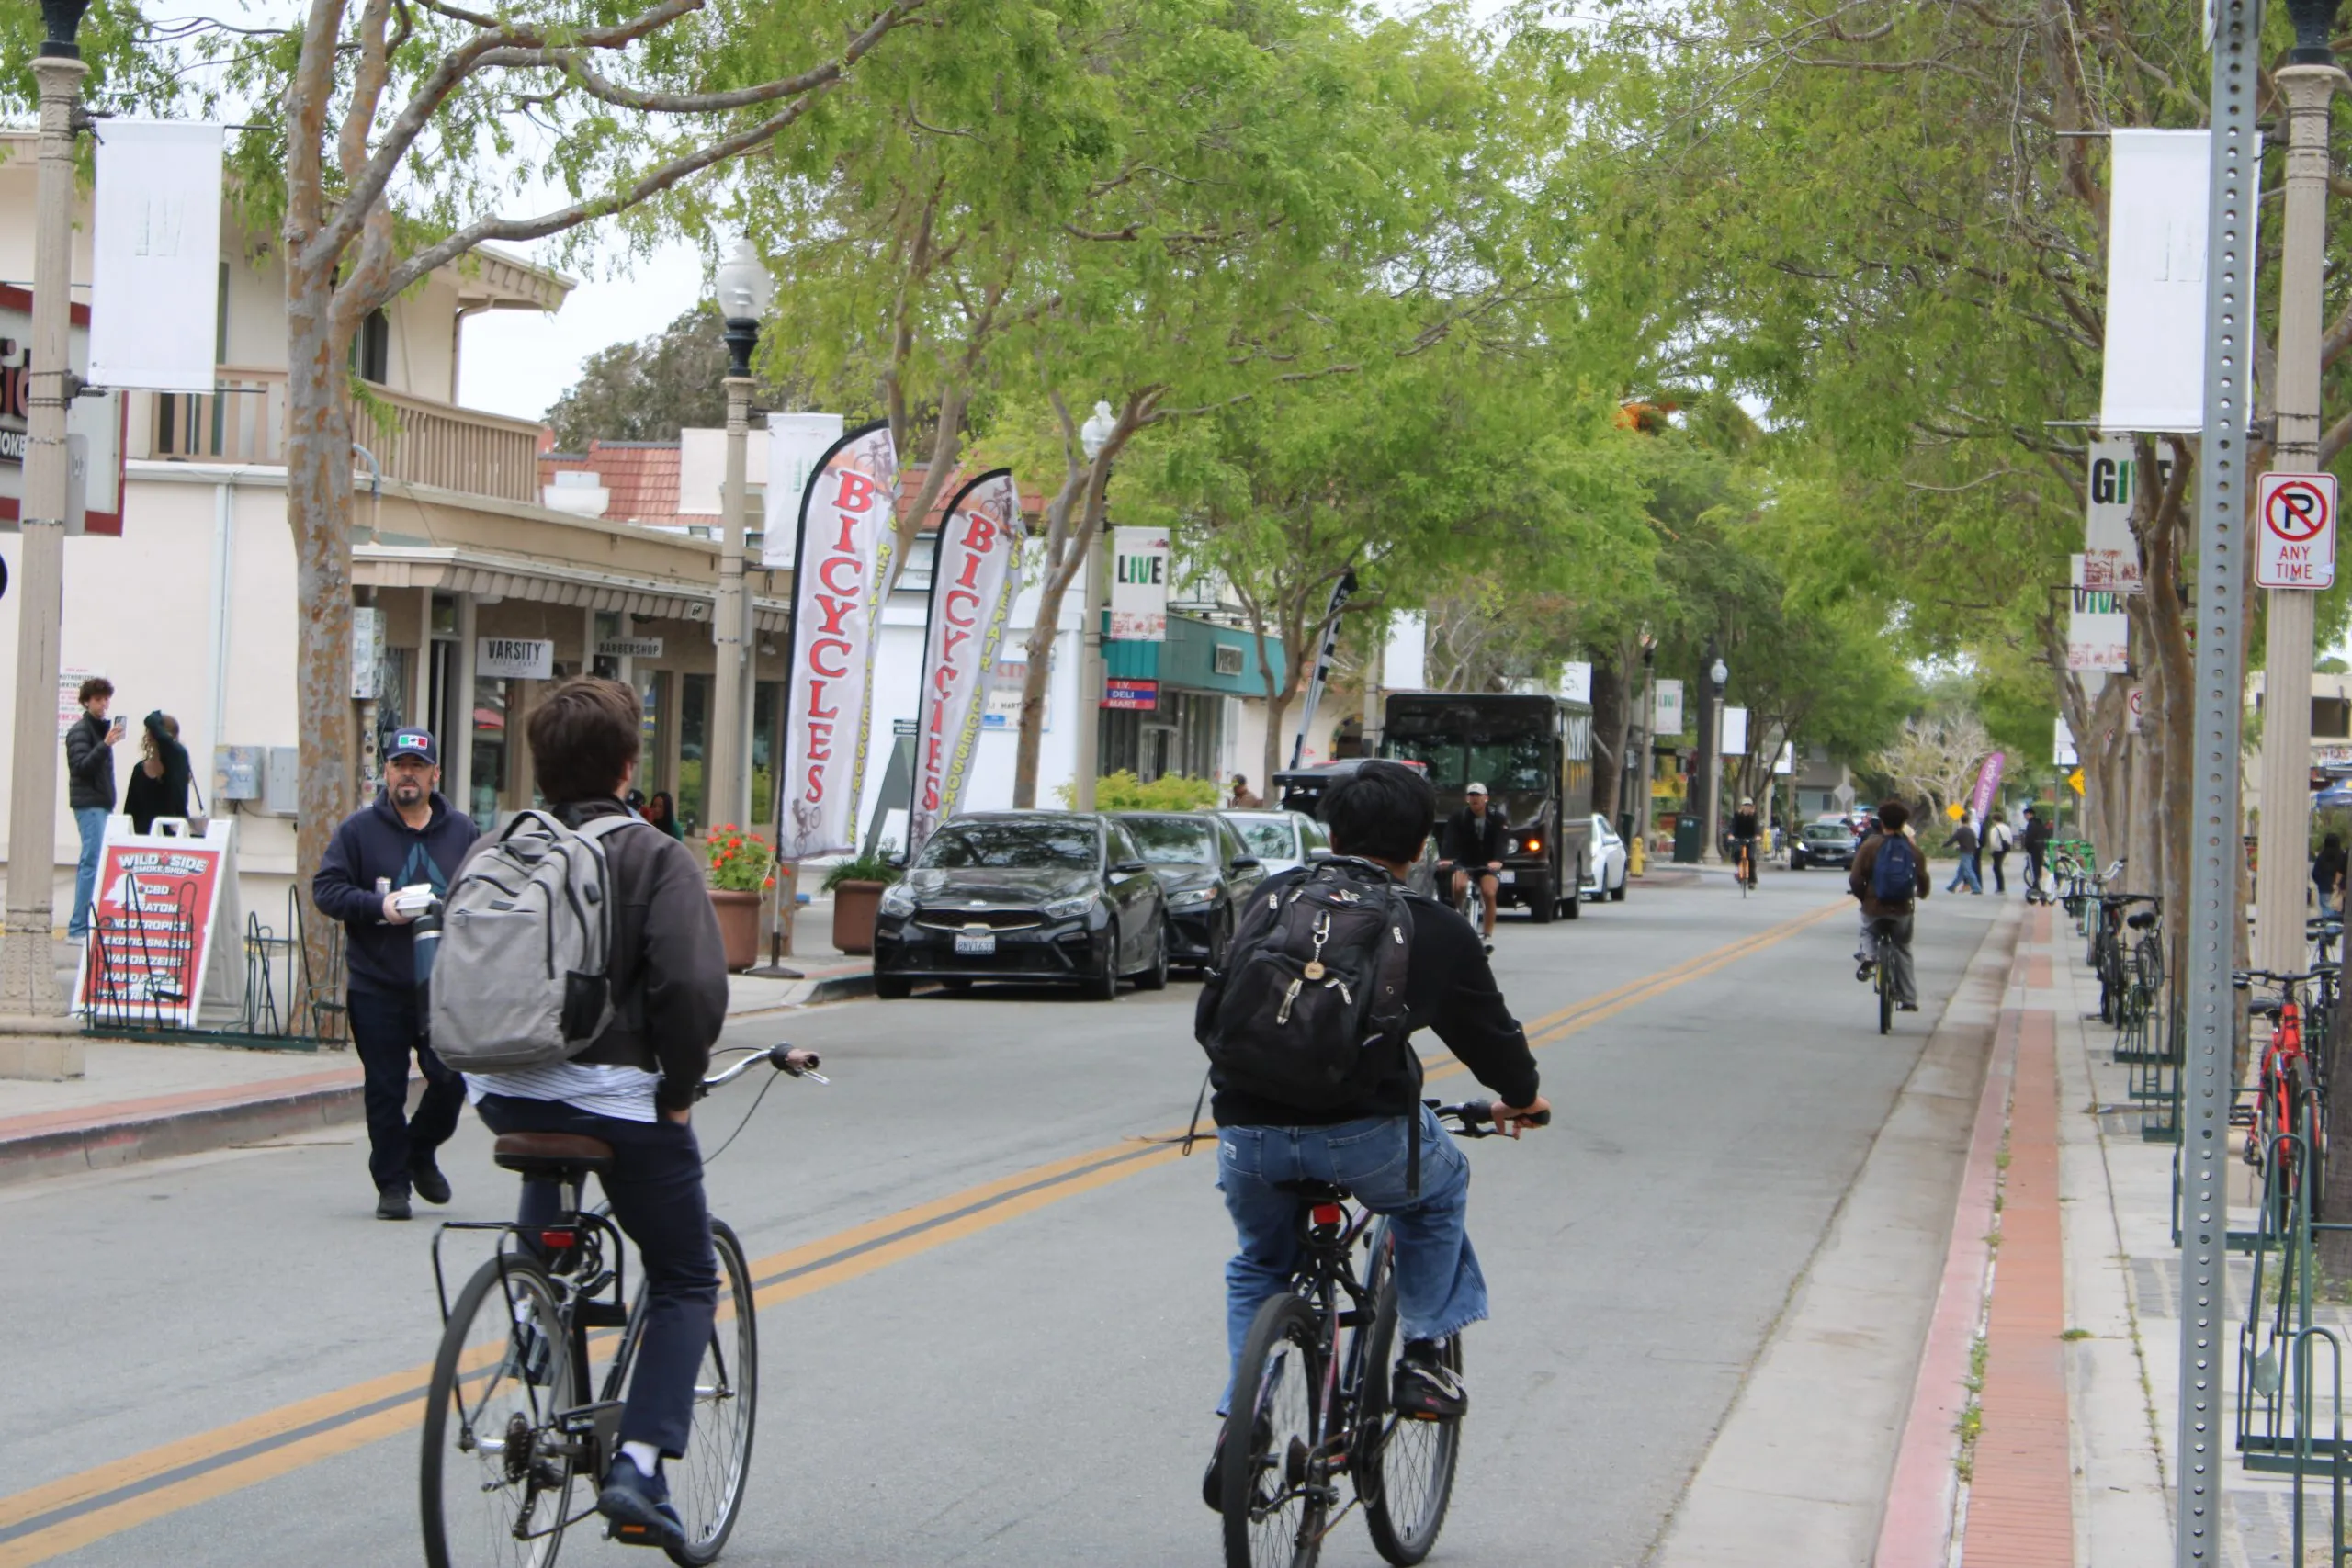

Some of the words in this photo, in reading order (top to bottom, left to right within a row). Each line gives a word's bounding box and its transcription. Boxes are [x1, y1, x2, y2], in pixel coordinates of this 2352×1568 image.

[2092, 458, 2172, 504] GIE
[2279, 546, 2311, 560] ANY
[1118, 555, 1163, 584] LIVE
[2276, 563, 2312, 579] TIME
[805, 470, 875, 803] BICYCLES
[489, 640, 542, 660] VARSITY
[599, 642, 660, 655] BARBERSHOP
[1112, 690, 1135, 698] DELI
[1109, 700, 1137, 708] MART
[118, 853, 159, 869] WILD
[170, 854, 207, 871] SIDE
[144, 885, 170, 895] CBD
